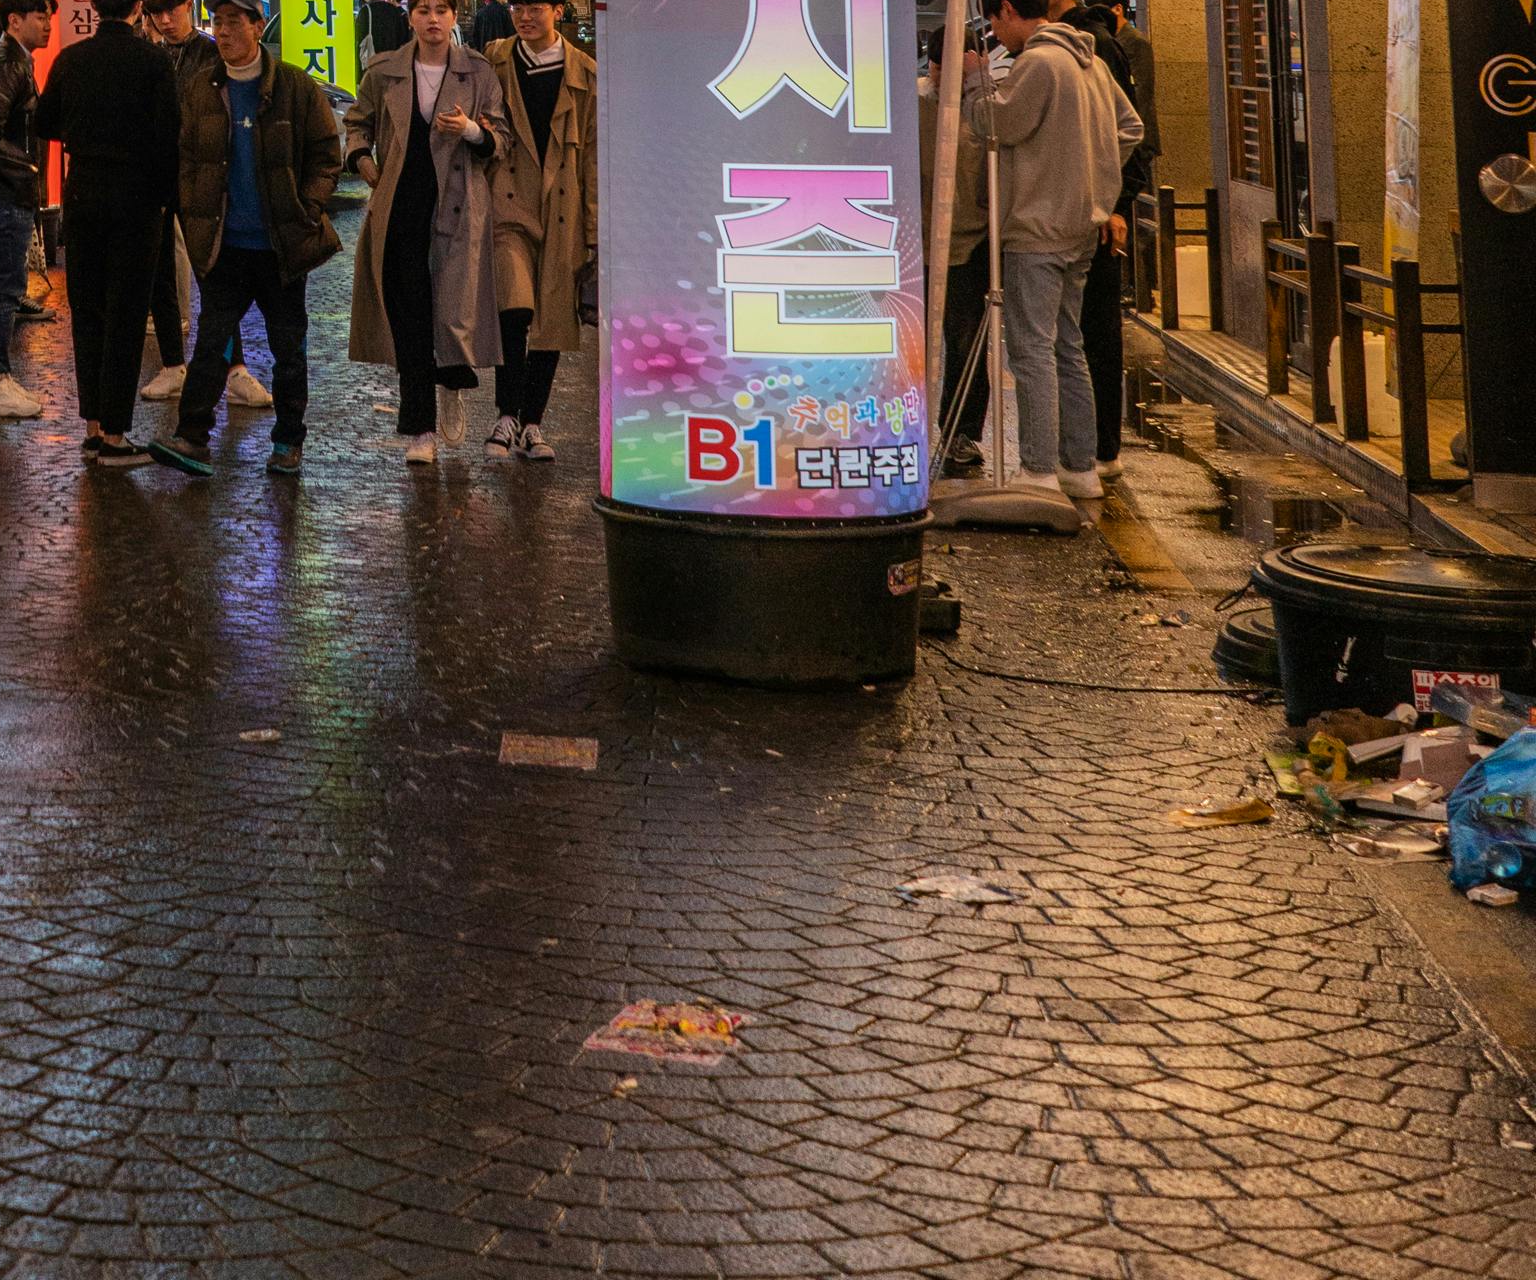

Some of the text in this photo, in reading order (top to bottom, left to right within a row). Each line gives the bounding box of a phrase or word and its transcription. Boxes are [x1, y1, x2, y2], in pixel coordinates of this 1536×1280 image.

[788, 385, 920, 440] 추억과 낭만
[685, 413, 920, 490] B1 단란주점
